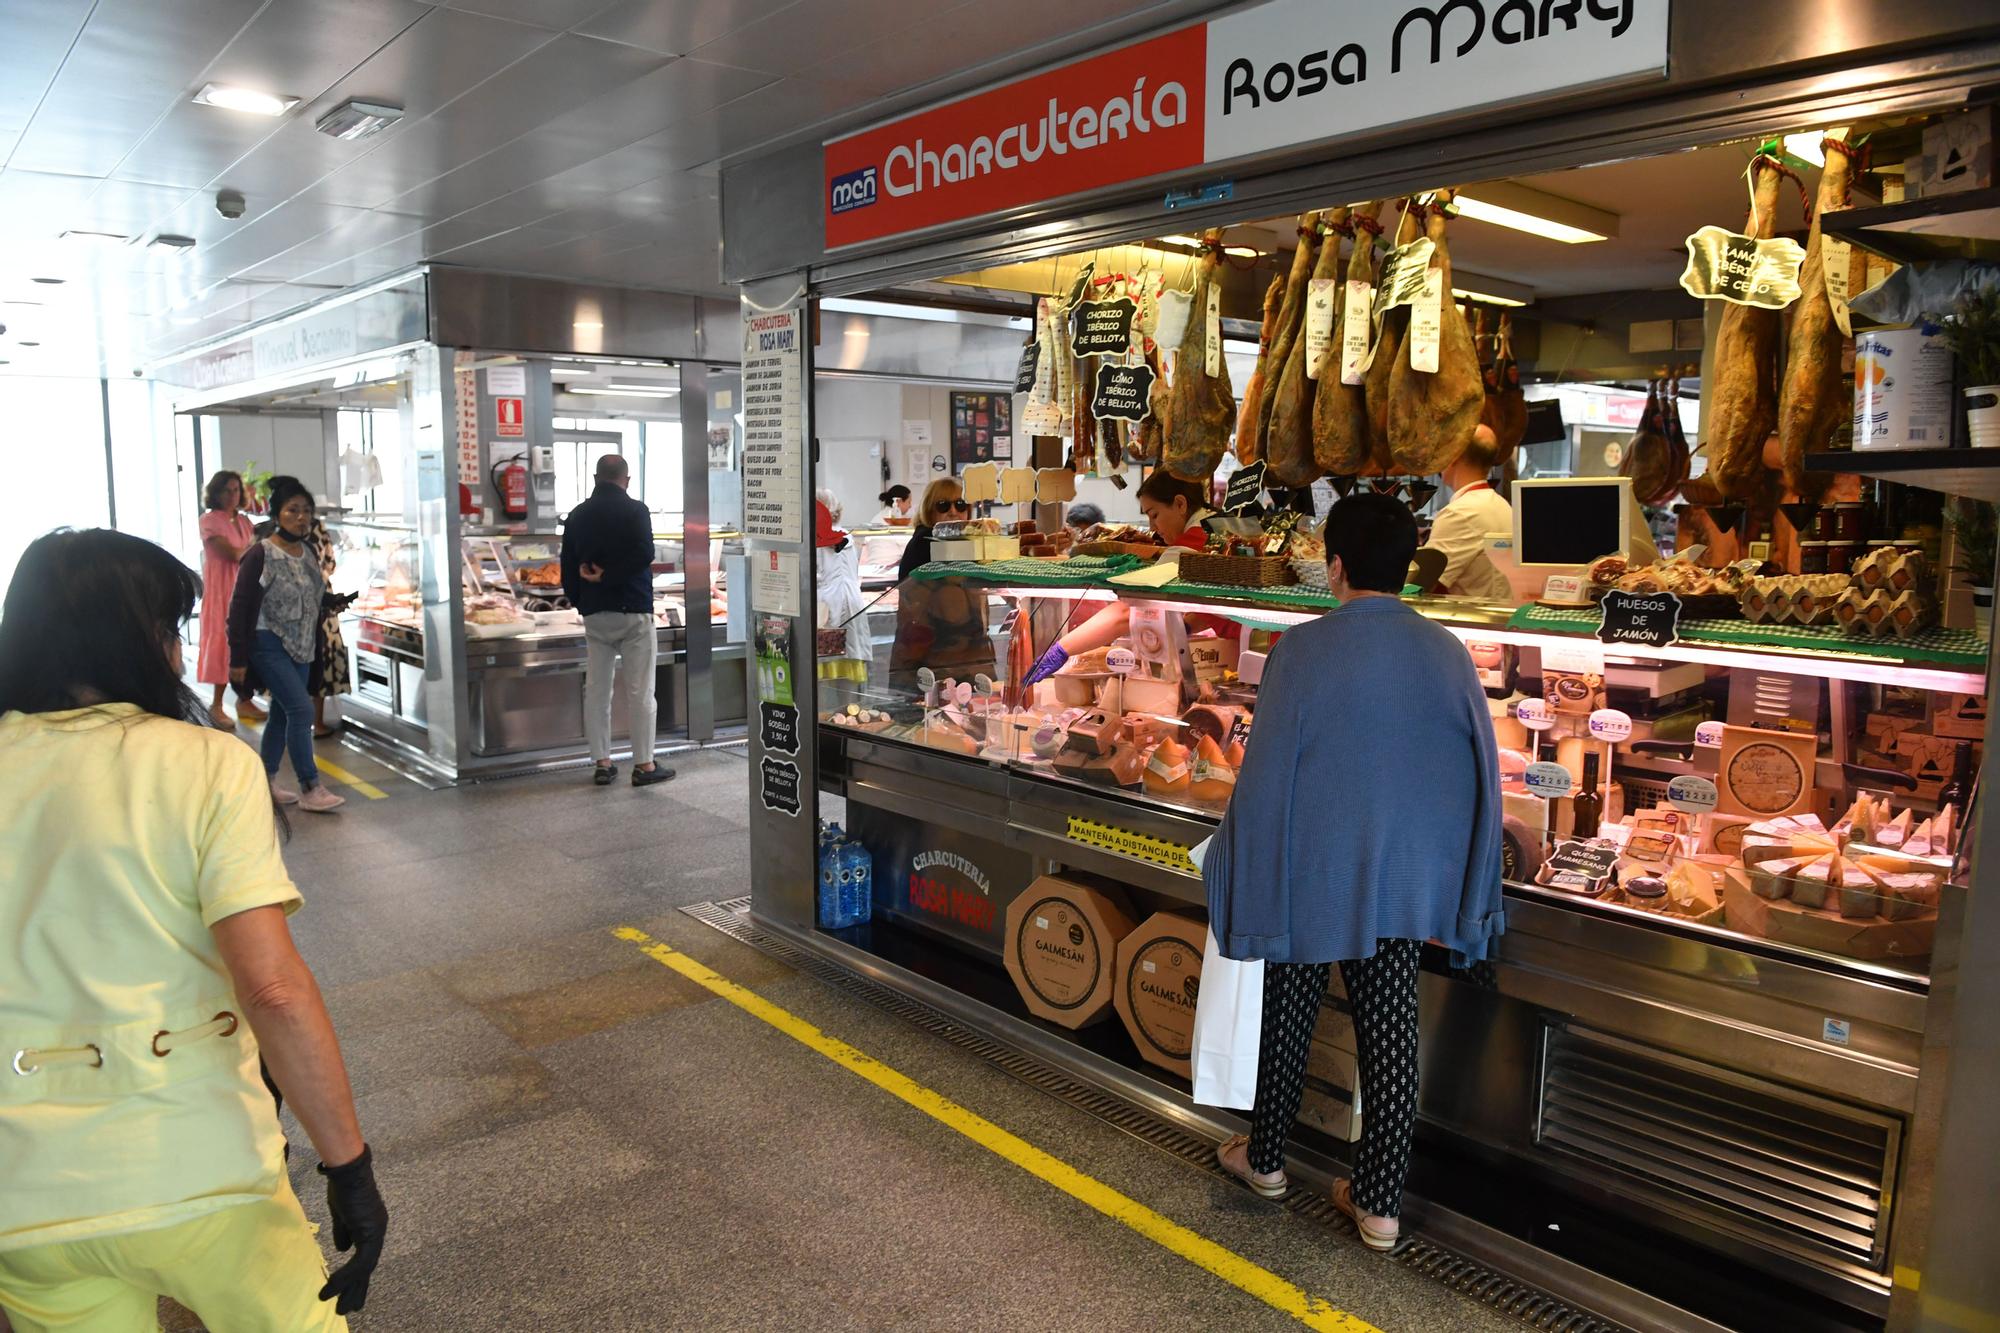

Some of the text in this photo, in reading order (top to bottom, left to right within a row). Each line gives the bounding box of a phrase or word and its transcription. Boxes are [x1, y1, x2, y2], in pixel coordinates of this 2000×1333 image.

[1223, 43, 1367, 116] Rosa
[883, 76, 1187, 198] Charcutería
[1711, 273, 1771, 294] DE CEBO
[1086, 309, 1123, 320] CHORIZO
[1086, 321, 1120, 332] IBÉRICO
[760, 329, 795, 352] ROSA MARY
[1078, 334, 1126, 345] DE BELLOTA
[1111, 374, 1134, 385] LOMO
[1105, 385, 1137, 397] IBÉRICO
[1097, 398, 1142, 410] DE BELLOTA
[1617, 598, 1667, 612] HUESOS
[1631, 615, 1648, 626] DE
[1612, 628, 1660, 641] JAMÓN
[1073, 824, 1115, 844] MANTEÑA
[1115, 835, 1121, 845] A
[1122, 839, 1170, 859] DISTANCIA
[1171, 851, 1184, 863] DE
[1570, 850, 1602, 861] QUESO
[909, 873, 948, 919] ROSA
